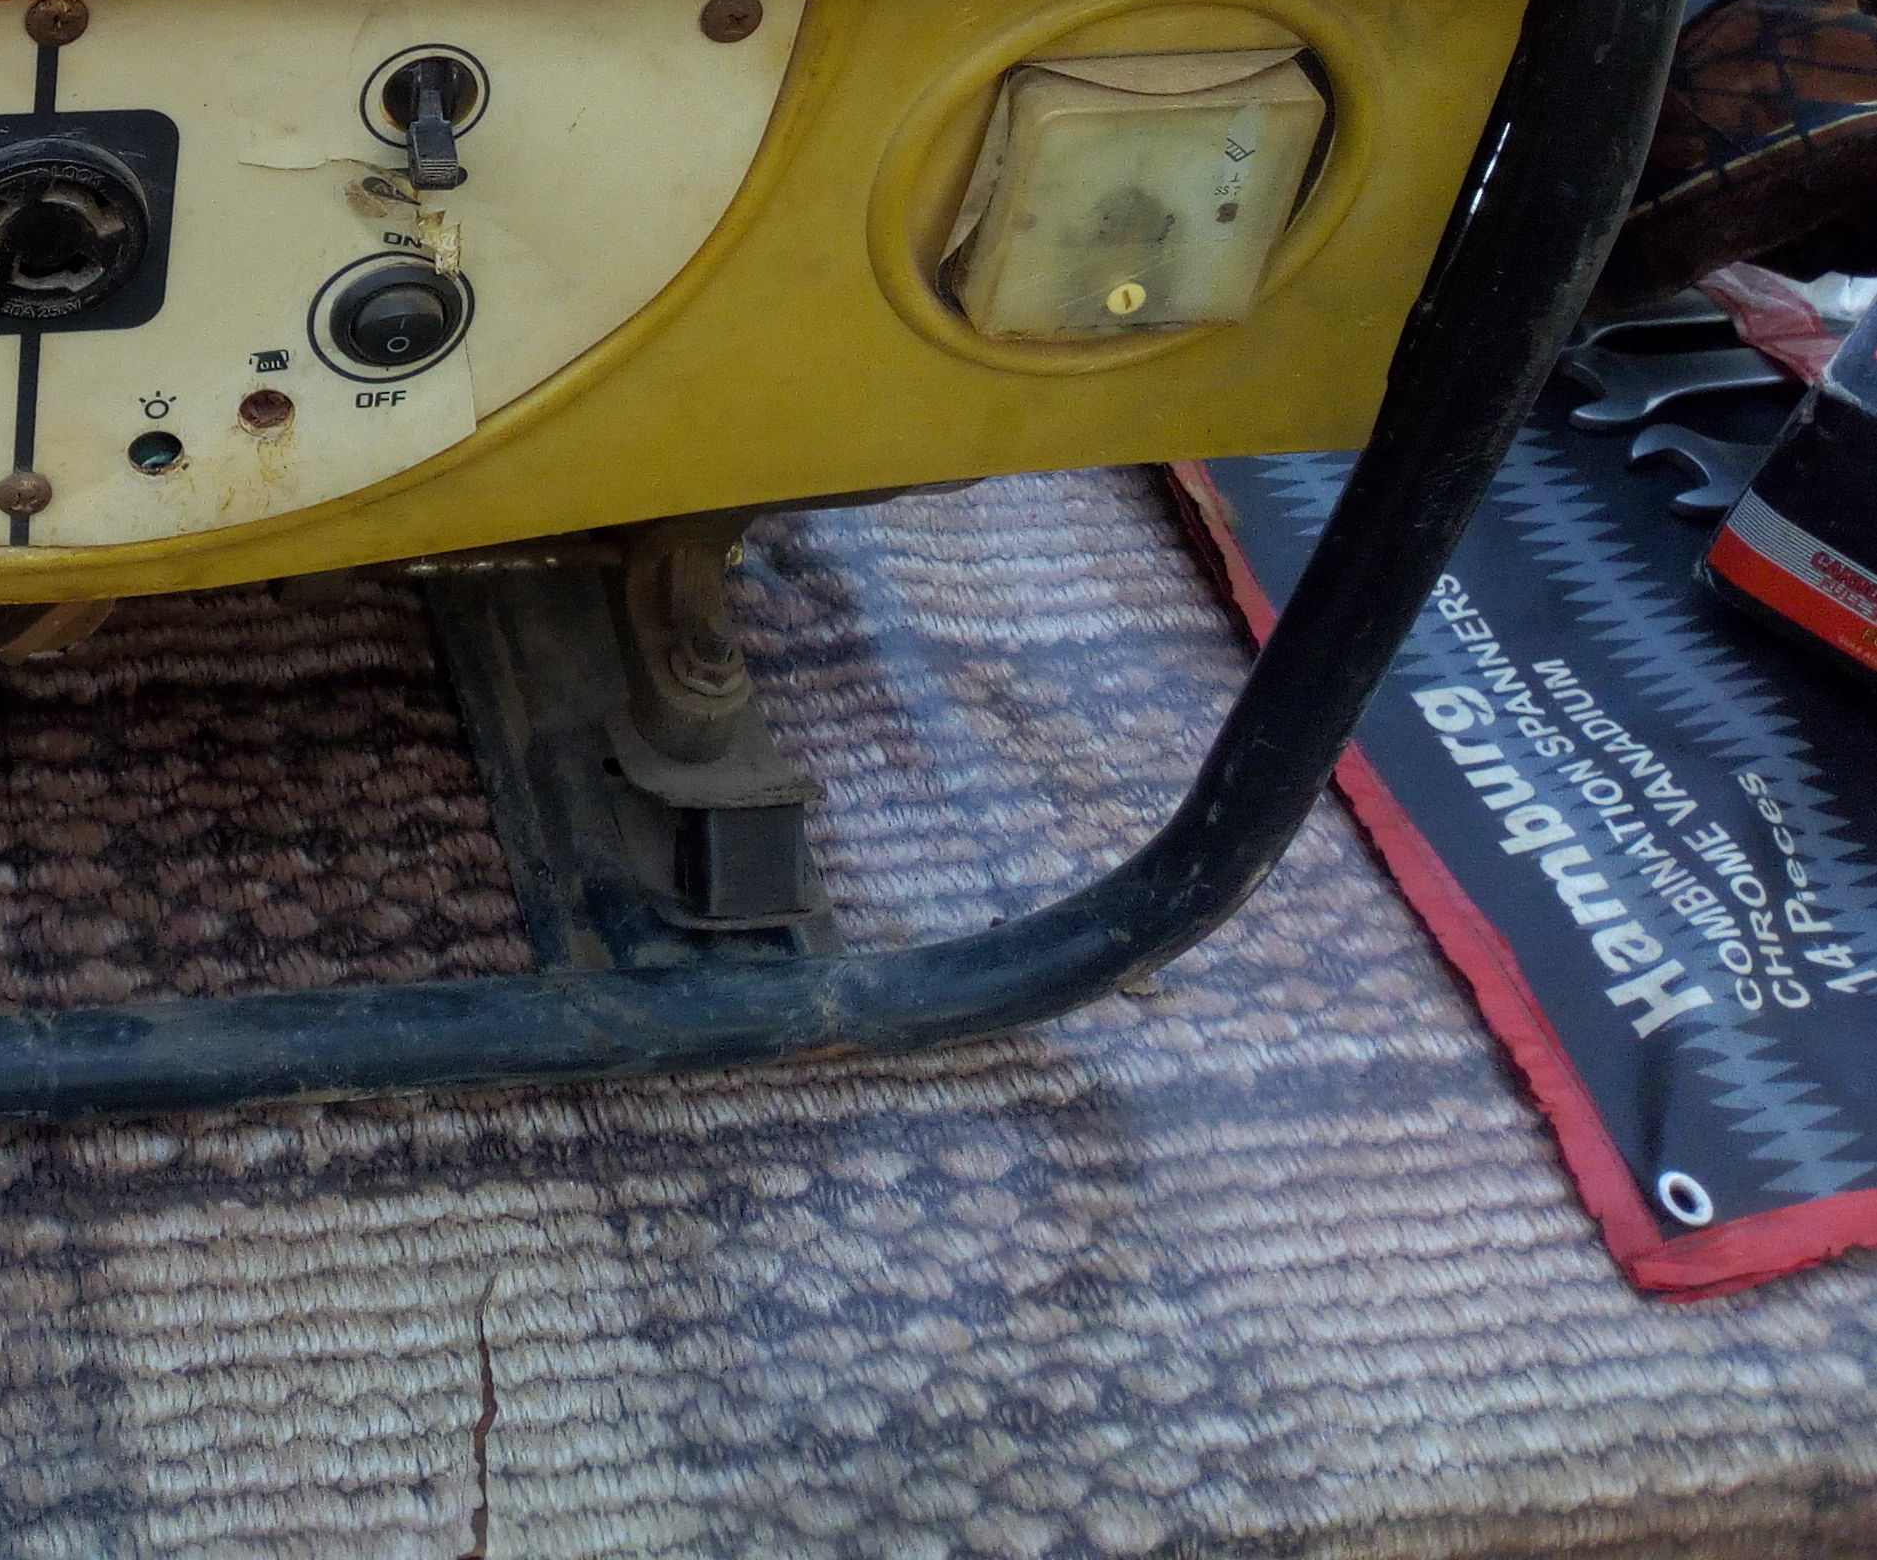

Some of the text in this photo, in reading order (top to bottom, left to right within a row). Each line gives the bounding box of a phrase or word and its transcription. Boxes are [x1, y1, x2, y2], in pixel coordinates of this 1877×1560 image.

[383, 231, 423, 249] ON
[355, 389, 407, 409] OFF
[1411, 686, 1714, 1040] Hamburg
[1431, 574, 1764, 1011] COMBINATION SPANNERS
[1532, 659, 1811, 1008] CHROME VANADIUM
[1737, 772, 1877, 993] 14 Pieces
